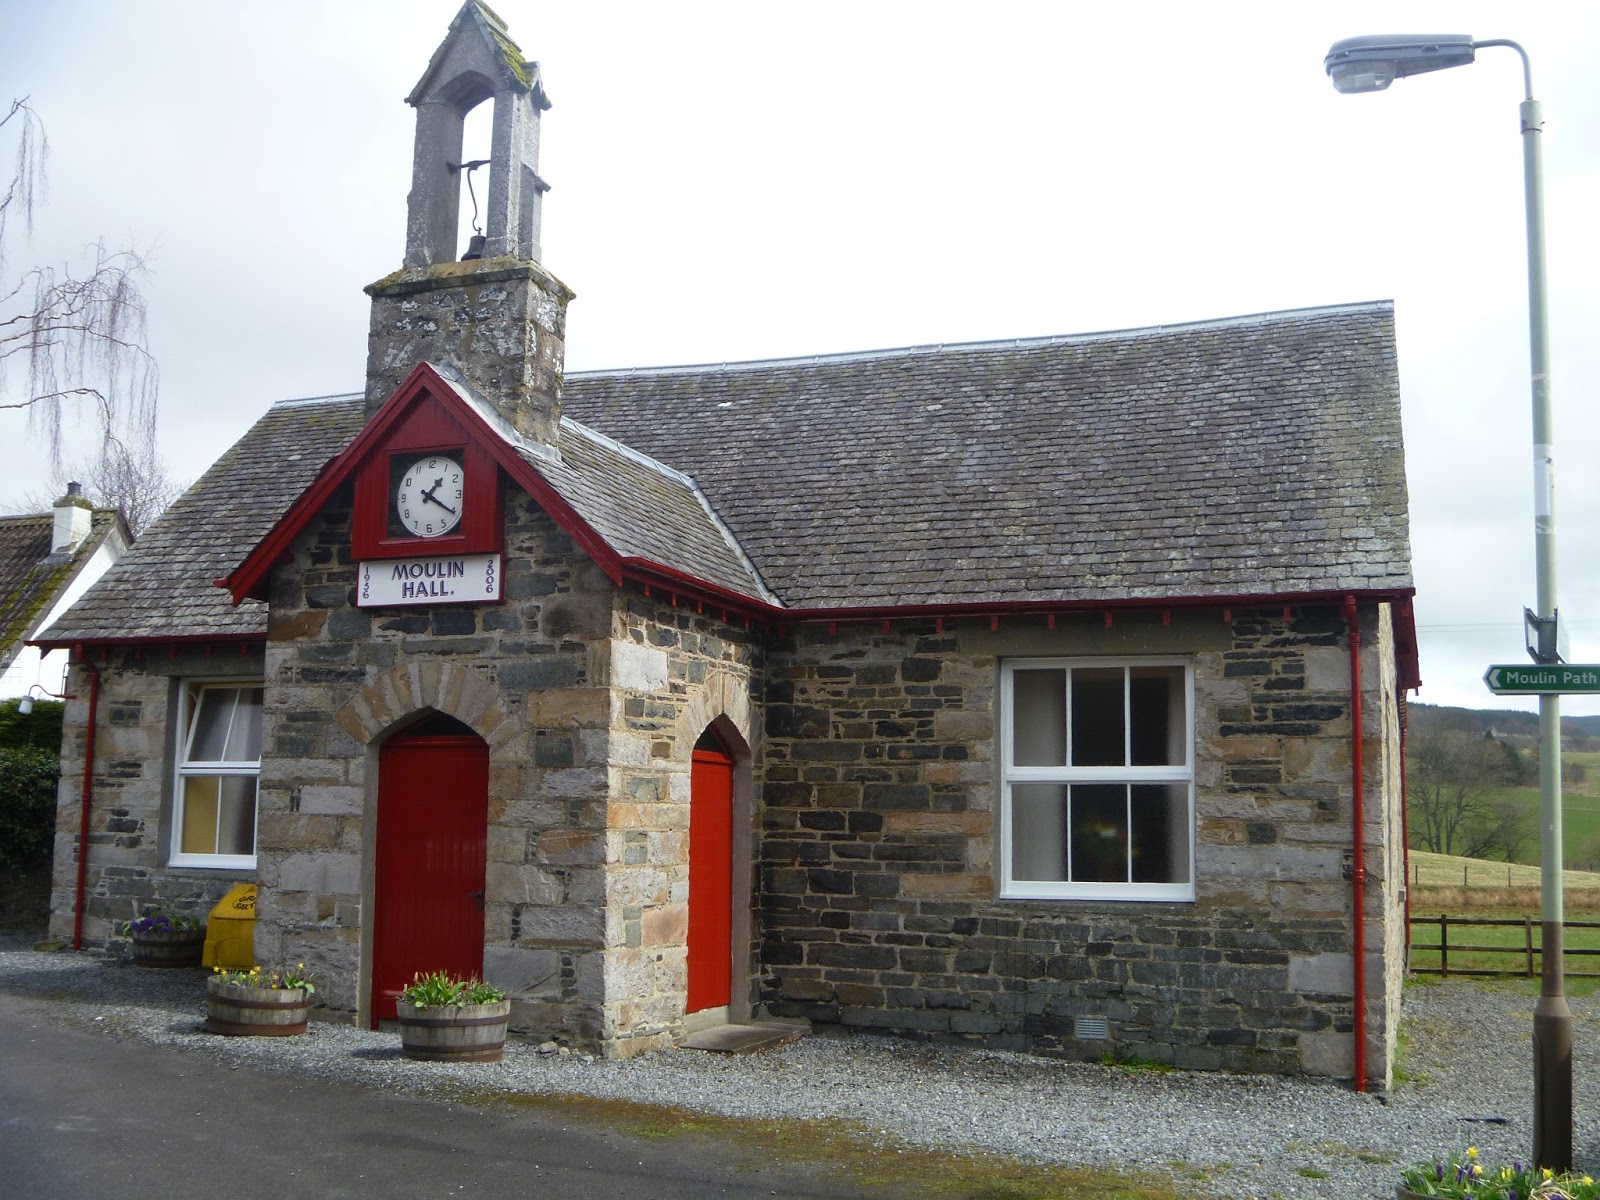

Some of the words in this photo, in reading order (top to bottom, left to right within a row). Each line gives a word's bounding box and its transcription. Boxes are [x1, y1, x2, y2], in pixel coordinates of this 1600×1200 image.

[428, 460, 437, 469] 12
[444, 463, 449, 473] 1
[415, 465, 421, 475] 11
[452, 474, 459, 484] 2
[401, 493, 407, 503] 9
[455, 489, 462, 499] 3
[404, 508, 410, 519] 8
[413, 520, 419, 530] 7
[426, 523, 433, 533] 6
[440, 519, 447, 529] 5
[391, 561, 464, 580] MOULIN
[486, 559, 494, 593] 2006
[402, 581, 454, 598] HALL.
[1506, 671, 1556, 684] Moulin
[1563, 671, 1597, 684] Path
